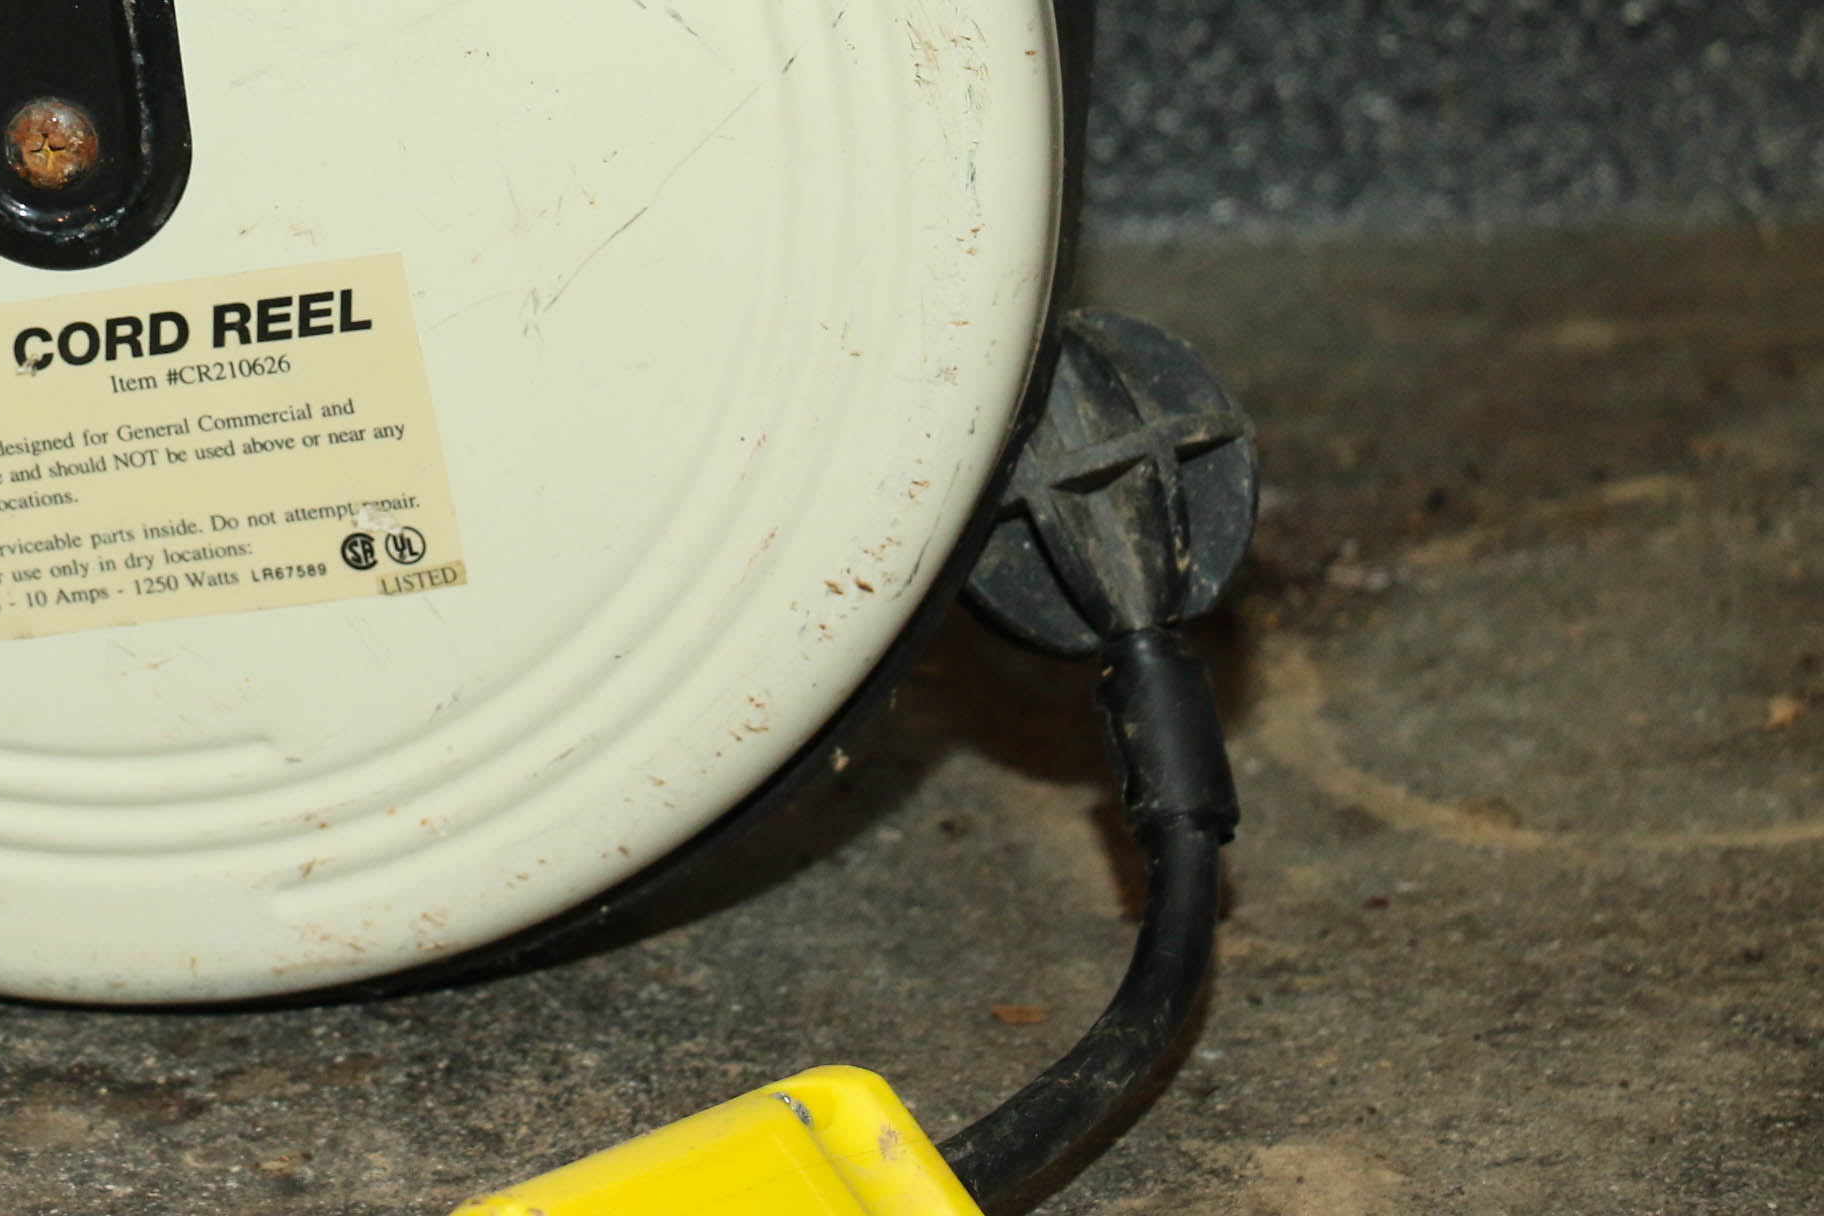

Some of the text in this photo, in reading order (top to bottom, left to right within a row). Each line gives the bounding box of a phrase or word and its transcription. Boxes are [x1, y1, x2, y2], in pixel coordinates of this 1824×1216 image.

[13, 288, 373, 373] CORD REEL
[110, 354, 291, 394] Item #CR210626
[83, 429, 109, 447] for
[117, 418, 190, 443] General
[198, 403, 313, 433] Commercial
[321, 397, 355, 418] and
[10, 460, 43, 483] and
[49, 452, 107, 478] should
[113, 447, 159, 472] NOT
[166, 445, 187, 465] be
[195, 441, 236, 461] used
[242, 435, 295, 457] above
[302, 432, 321, 448] or
[328, 425, 366, 445] near
[373, 421, 406, 442] any
[90, 528, 136, 551] parts
[143, 517, 203, 540] inside.
[211, 514, 239, 532] Do
[247, 510, 277, 527] not
[284, 502, 356, 525] attempt
[12, 567, 42, 583] use
[50, 559, 90, 581] only
[98, 556, 117, 573] in
[124, 550, 155, 572] dry
[164, 542, 254, 565] locations:
[26, 590, 48, 609] 10
[56, 583, 110, 609] Amps
[133, 574, 179, 596] 1250
[185, 567, 239, 591] Watts
[250, 562, 328, 584] LR67589
[380, 566, 458, 596] LISTED
